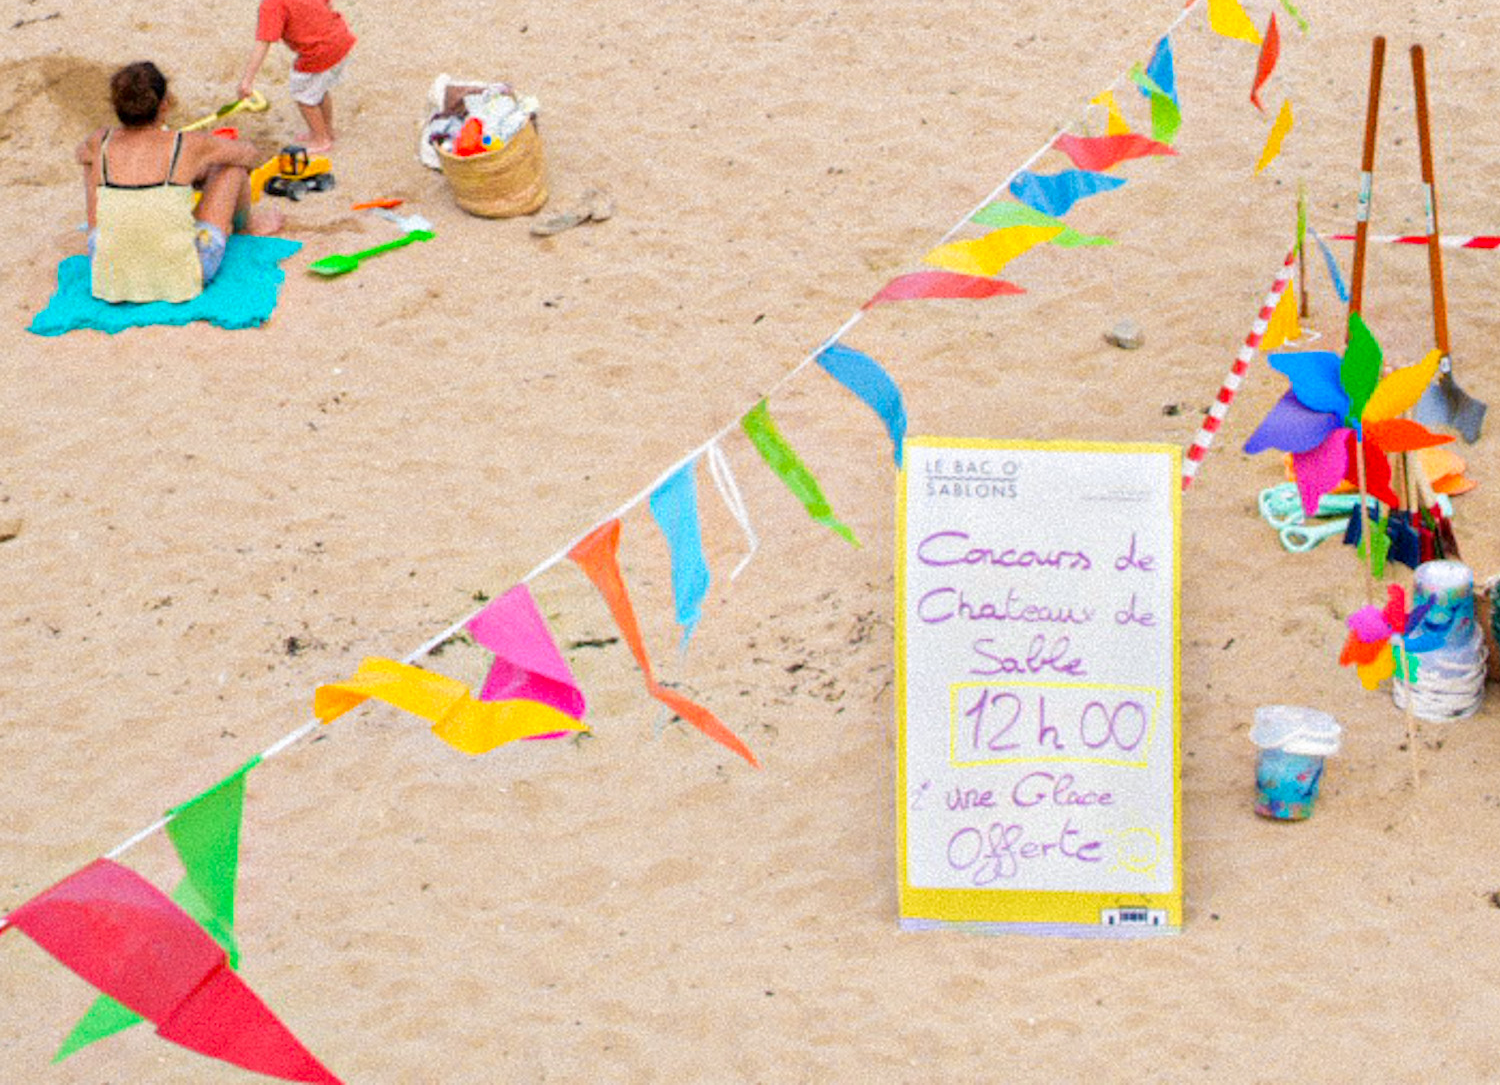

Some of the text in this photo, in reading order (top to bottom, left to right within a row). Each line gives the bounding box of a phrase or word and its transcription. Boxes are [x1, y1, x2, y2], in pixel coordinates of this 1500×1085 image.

[924, 458, 942, 474] LE
[953, 459, 993, 476] BAC
[925, 481, 1019, 499] SABLONS
[916, 530, 1157, 572] Concours de
[1114, 591, 1157, 627] de
[968, 633, 1088, 676] Sable
[945, 784, 998, 811] une
[1011, 770, 1116, 808] Glace
[946, 818, 1103, 886] Offerte
